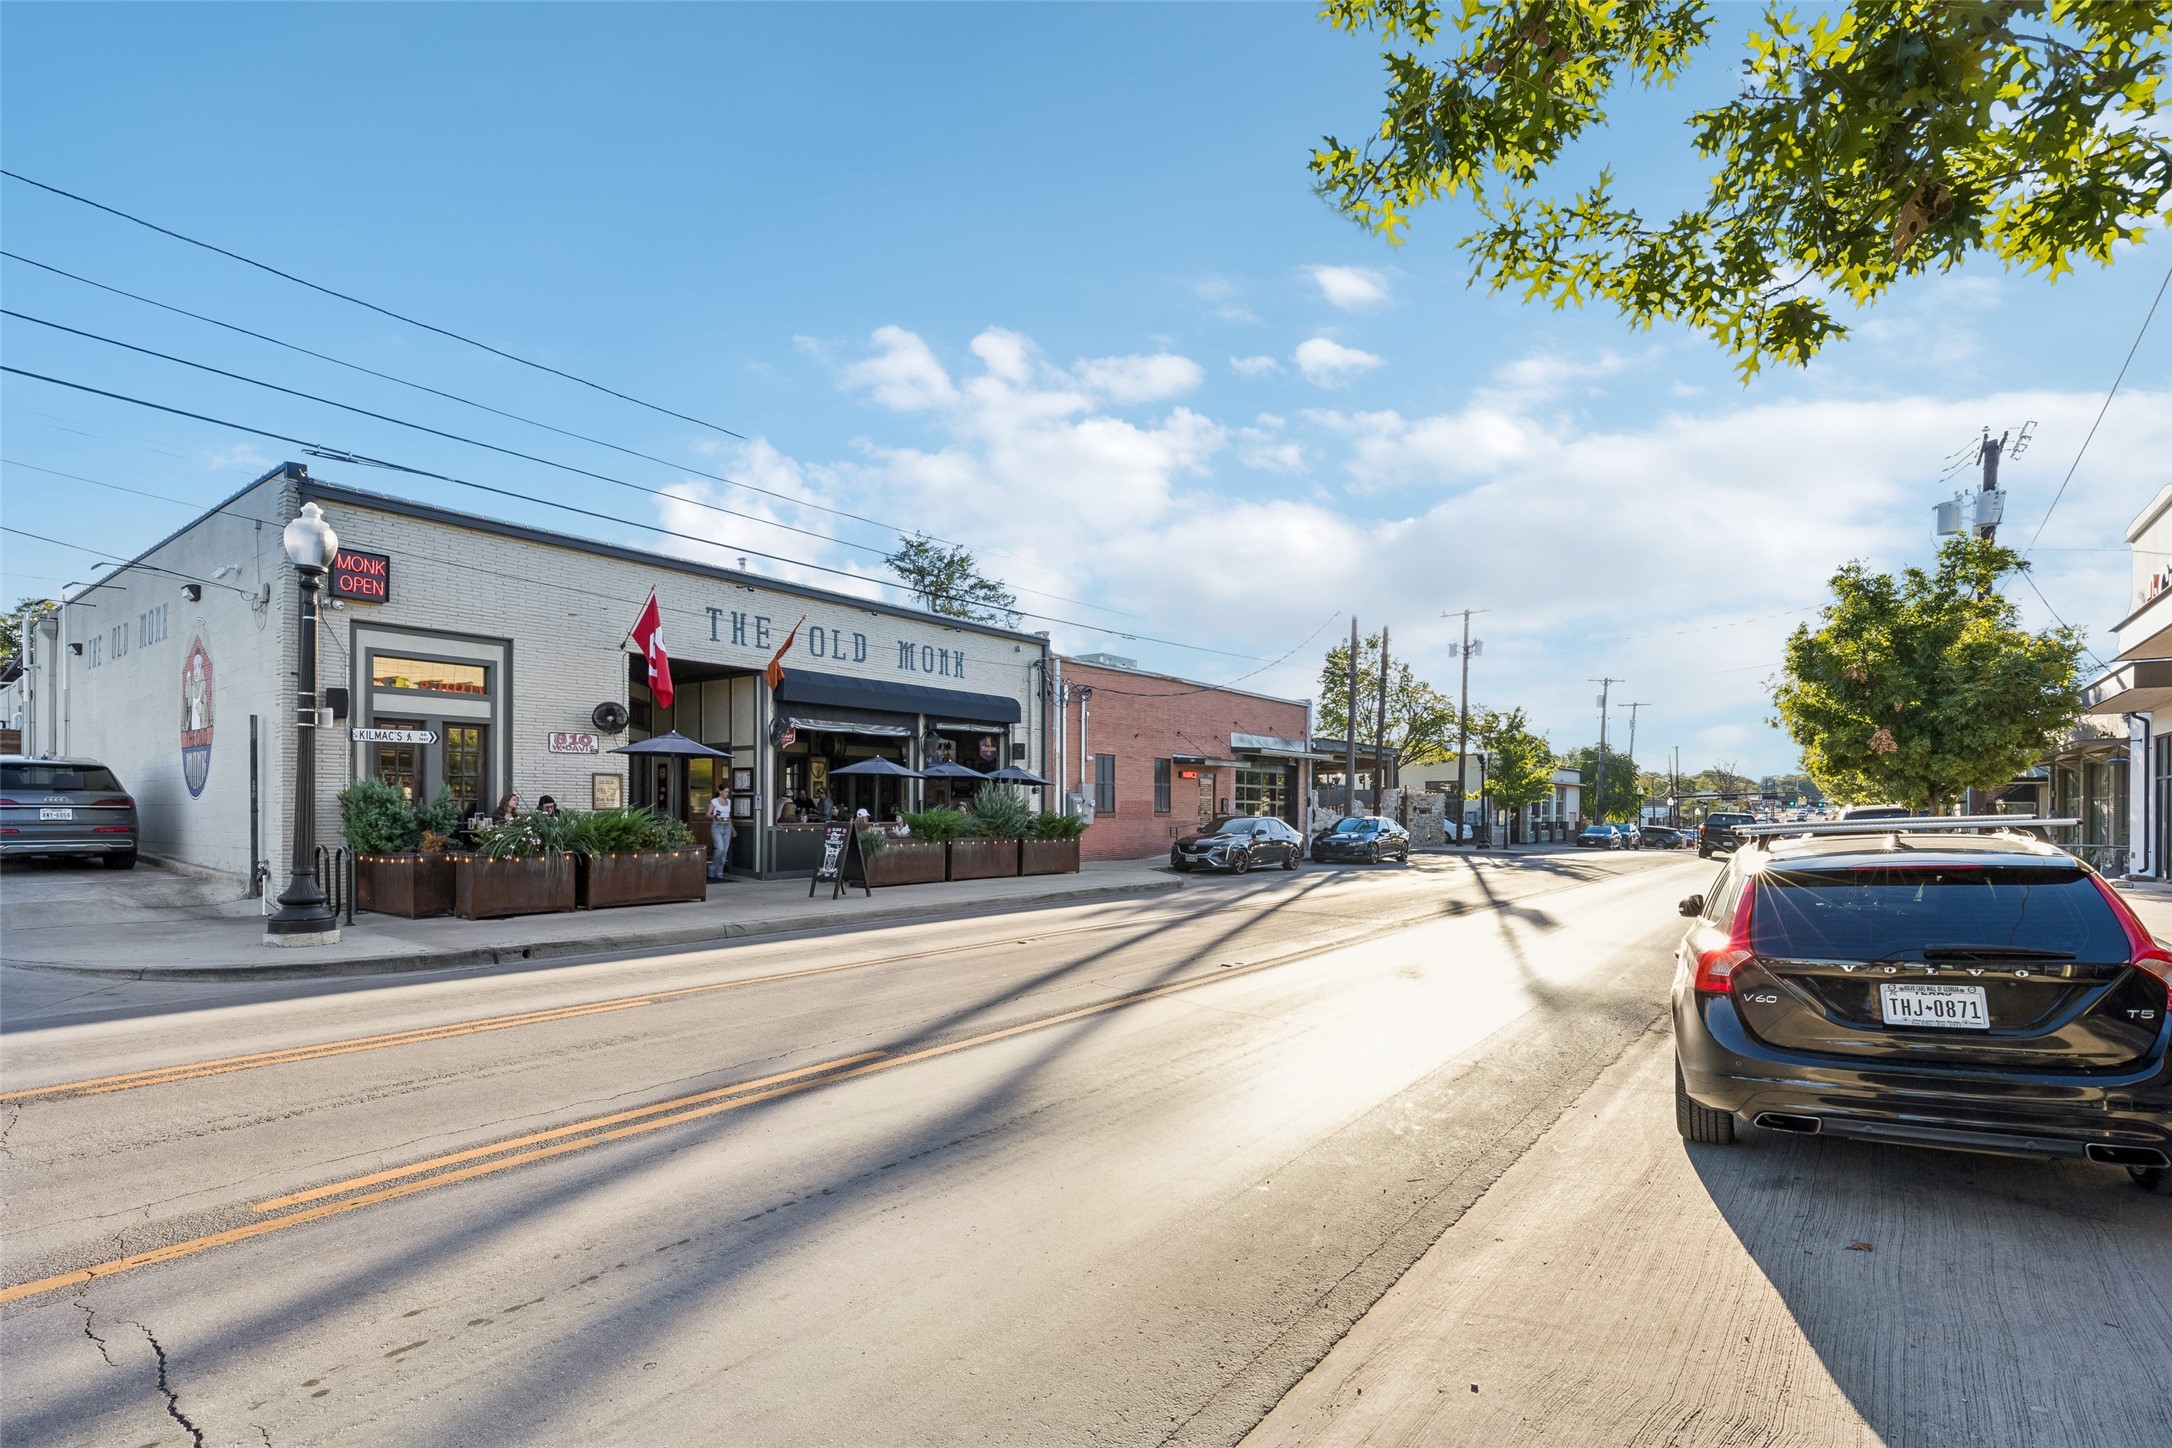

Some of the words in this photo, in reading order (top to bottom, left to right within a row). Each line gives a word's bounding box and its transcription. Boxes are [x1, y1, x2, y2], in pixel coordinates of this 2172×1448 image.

[336, 553, 386, 577] MONK
[340, 575, 384, 596] OPEN
[88, 635, 102, 670] THE
[111, 622, 129, 660] OLD
[139, 602, 168, 649] MONK
[705, 606, 771, 650] THE
[809, 625, 867, 664] OLD
[897, 639, 965, 679] MONK
[359, 730, 403, 742] KILMAC'S
[553, 732, 593, 747] 810
[1840, 964, 2029, 978] VOLVO
[1743, 993, 1778, 1004] V60
[2126, 1009, 2155, 1019] T5
